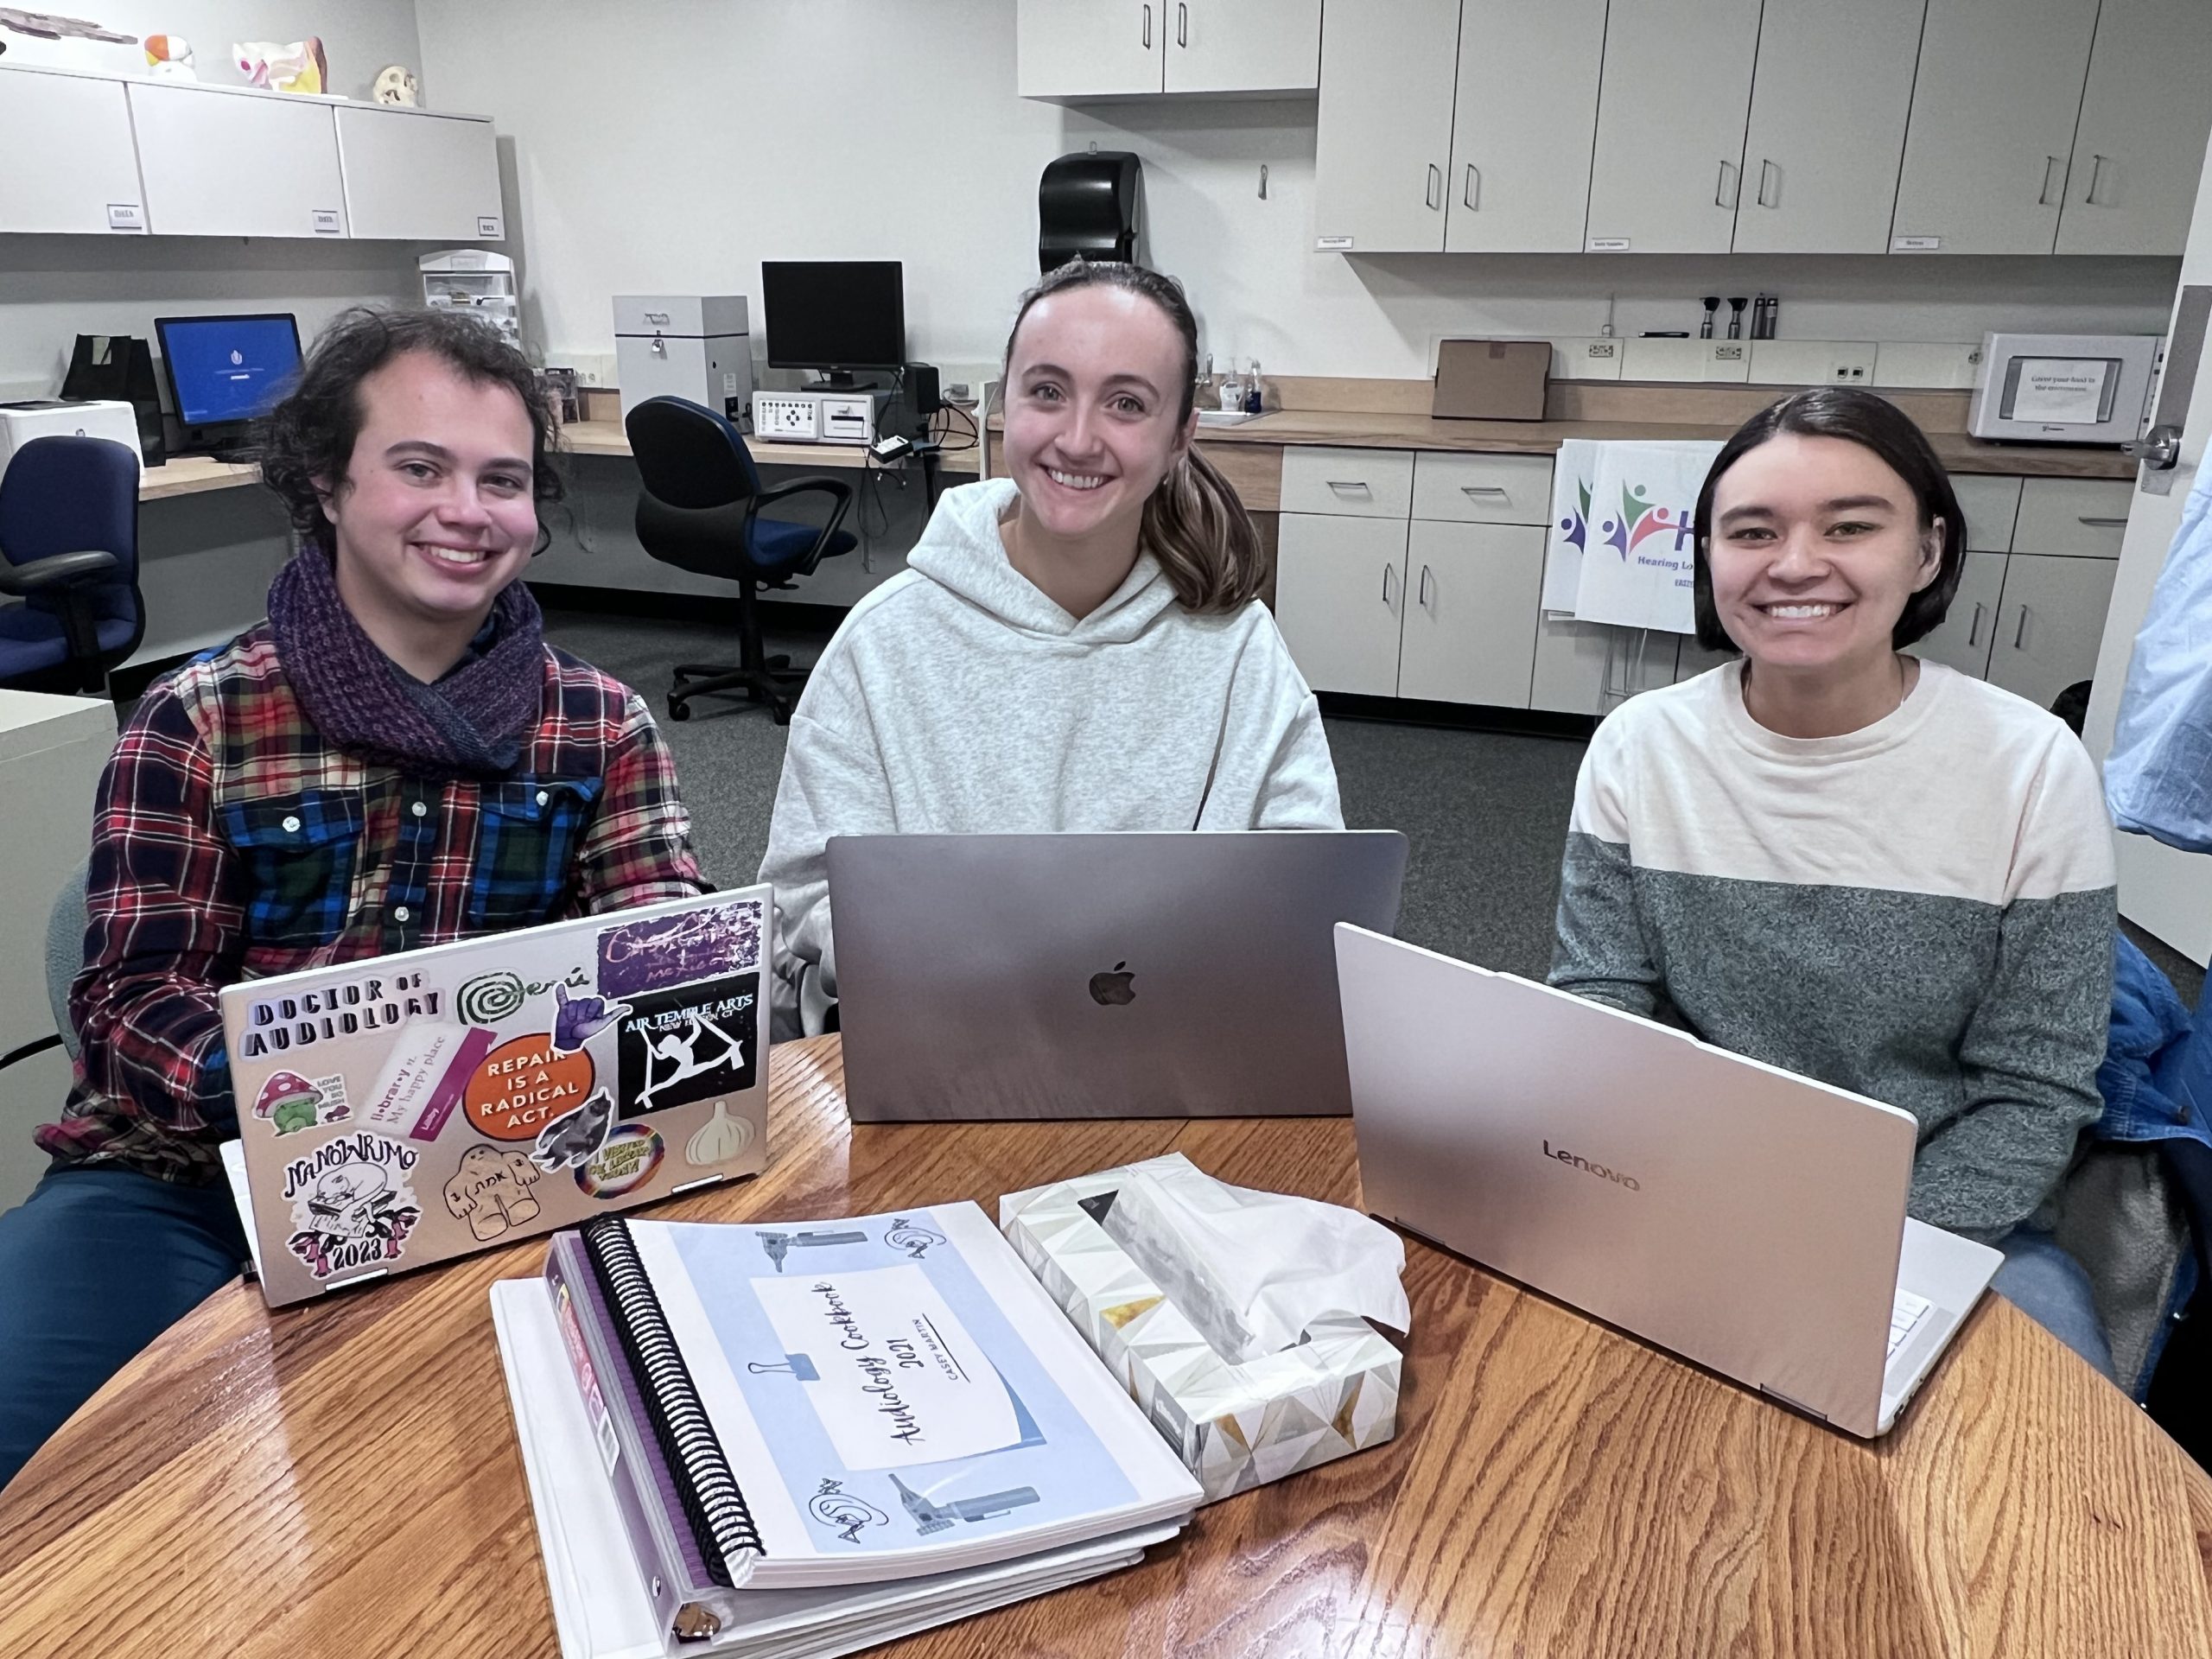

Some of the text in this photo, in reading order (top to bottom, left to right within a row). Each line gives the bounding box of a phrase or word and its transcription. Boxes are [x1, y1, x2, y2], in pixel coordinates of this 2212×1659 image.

[1638, 556, 1679, 570] Hearing
[254, 973, 422, 1026] DOCTOR OF
[625, 993, 753, 1033] AIR TEMPLE ARTS
[721, 1008, 734, 1019] CT
[245, 992, 439, 1057] AUDIOLOGY
[386, 1036, 445, 1124] My happy place
[487, 1050, 566, 1077] REPAIR
[317, 1076, 340, 1087] LOVE
[322, 1084, 342, 1094] YOU
[507, 1070, 550, 1091] IS A
[480, 1081, 580, 1116] RADICAL
[506, 1106, 555, 1128] ACT.
[1543, 1140, 1640, 1192] Lenovo
[333, 1237, 382, 1270] 2023
[810, 1281, 925, 1446] Audiology Cookbook
[886, 1338, 925, 1369] 2021
[912, 1319, 958, 1381] CASEY MARTIN
